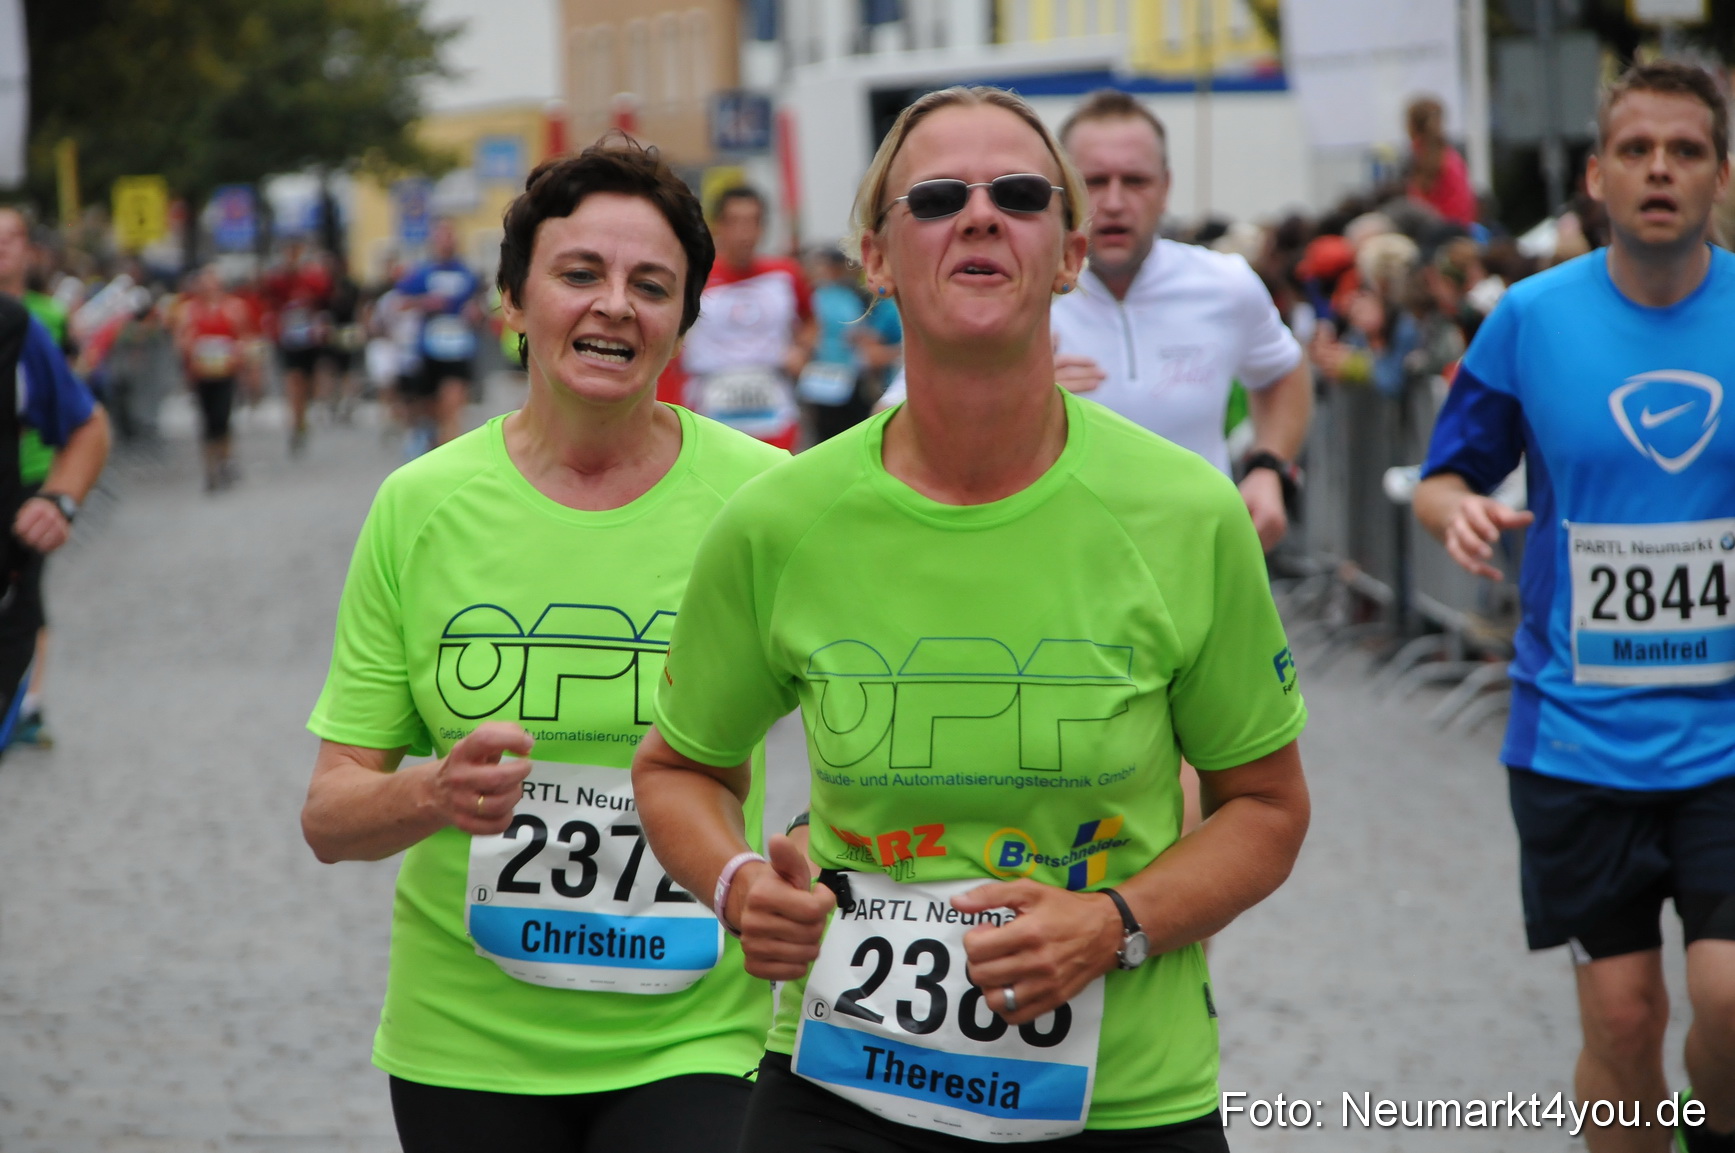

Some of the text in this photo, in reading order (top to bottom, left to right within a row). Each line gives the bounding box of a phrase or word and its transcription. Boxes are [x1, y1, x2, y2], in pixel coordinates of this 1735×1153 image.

[1575, 538, 1714, 554] PARTL Neumarkt
[1590, 561, 1730, 621] 2844
[1614, 637, 1708, 661] Manfred
[815, 762, 1136, 789] ebäude- und Automatisierungstechnik GmbH
[521, 781, 569, 803] RTL
[999, 836, 1133, 869] Bretschneider
[477, 888, 488, 902] D
[925, 901, 1016, 928] Neuma
[521, 919, 666, 961] Christine
[815, 1002, 825, 1018] C
[862, 1046, 1021, 1110] Theresia
